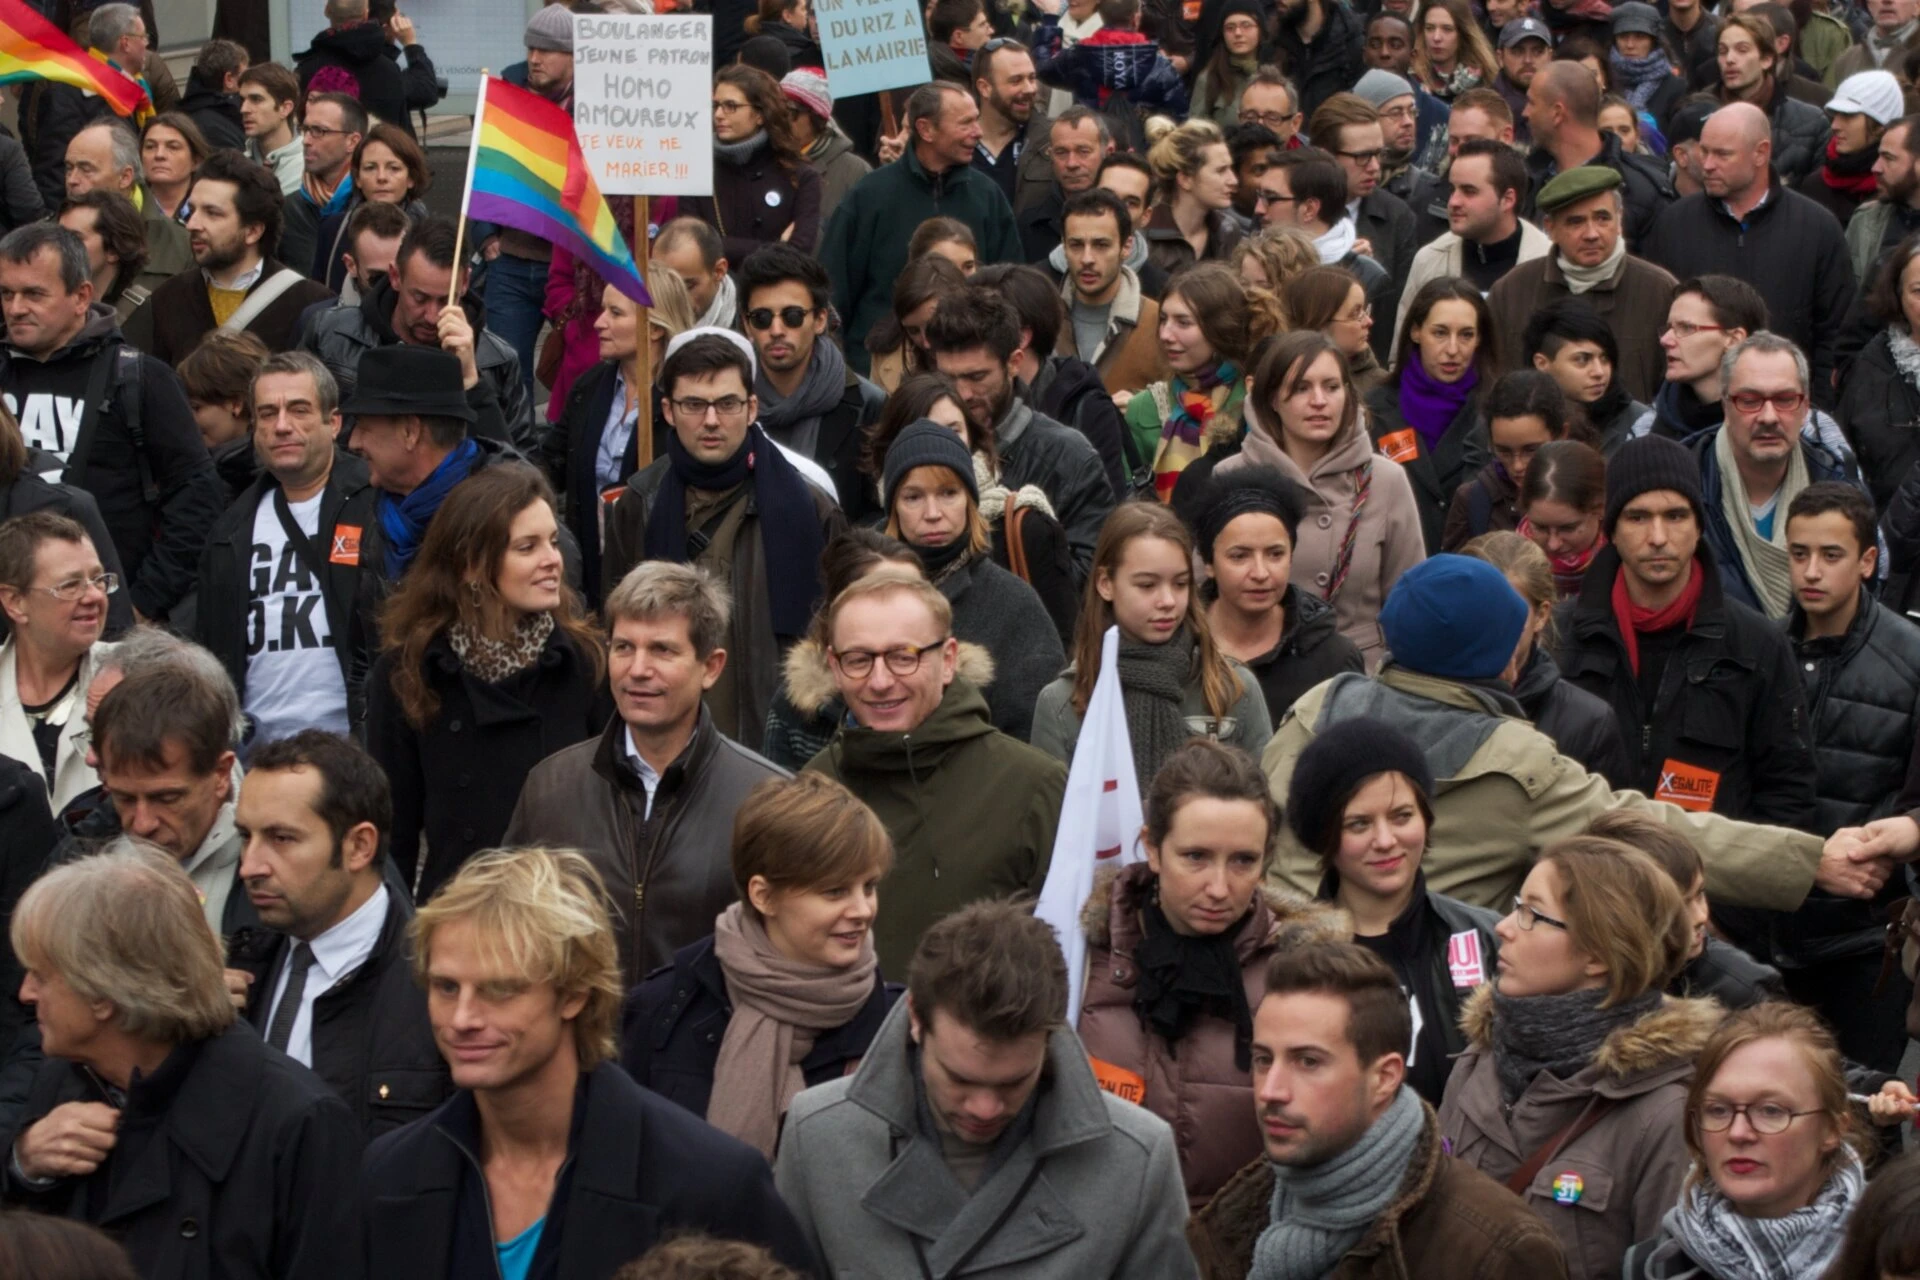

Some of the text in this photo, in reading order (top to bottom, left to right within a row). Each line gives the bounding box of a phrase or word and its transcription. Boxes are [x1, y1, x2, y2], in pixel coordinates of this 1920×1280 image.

[577, 18, 707, 41] BOULANGER
[830, 18, 858, 39] DU
[861, 12, 897, 35] RIZ
[575, 45, 710, 66] JEUNE PATRON
[826, 37, 927, 70] LA MAIRIE
[603, 73, 673, 100] HOMO
[576, 102, 699, 130] AMOUREUX
[606, 134, 643, 150] VEUX
[659, 137, 682, 152] ME
[1558, 1181, 1575, 1198] 31
